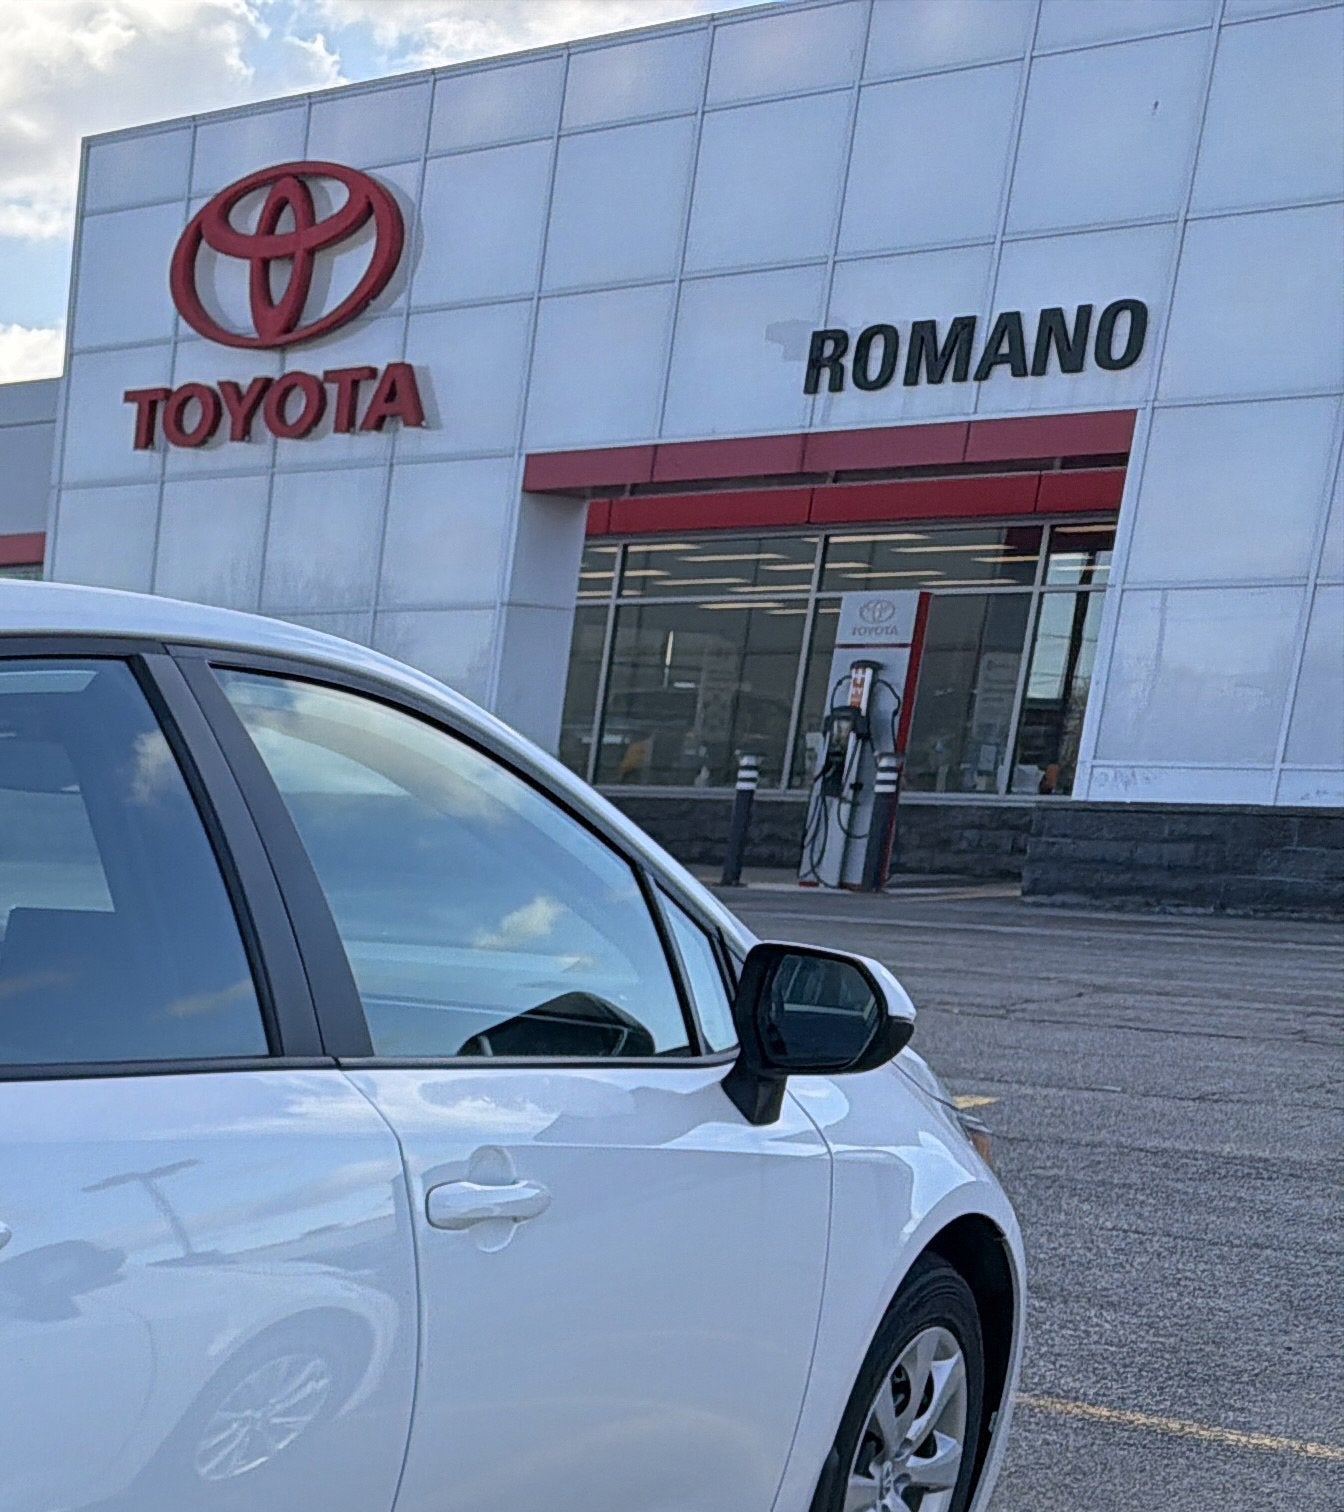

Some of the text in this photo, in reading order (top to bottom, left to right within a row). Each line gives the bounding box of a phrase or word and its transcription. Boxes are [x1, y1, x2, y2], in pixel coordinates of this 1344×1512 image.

[803, 298, 1149, 394] ROMANO
[123, 362, 426, 451] TOYOTA
[851, 625, 899, 637] TOYOTA
